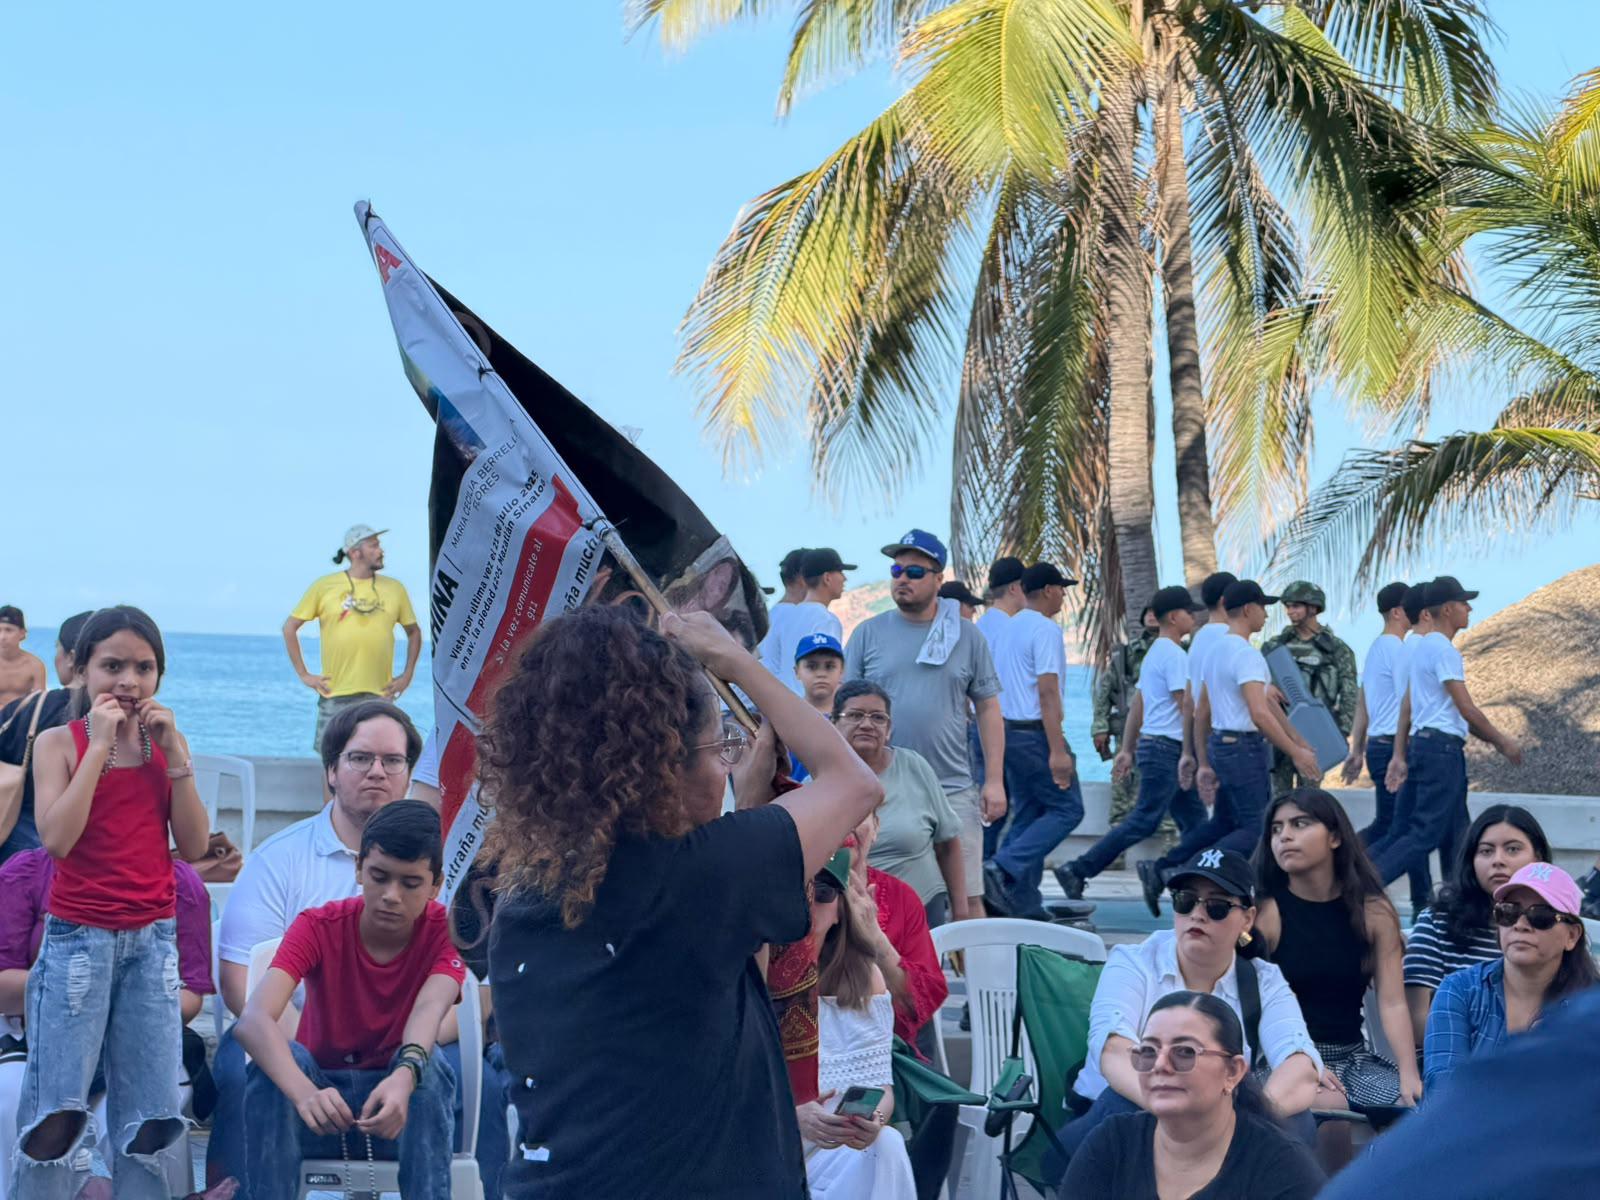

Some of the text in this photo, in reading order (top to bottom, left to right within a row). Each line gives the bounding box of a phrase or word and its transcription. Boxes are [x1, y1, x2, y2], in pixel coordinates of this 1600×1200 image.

[520, 470, 539, 497] 2025
[496, 498, 519, 525] julio
[451, 516, 469, 548] MARIA
[495, 523, 502, 537] de
[489, 548, 497, 561] el
[483, 562, 494, 580] vez
[500, 639, 511, 652] la
[506, 616, 520, 638] vez
[534, 538, 543, 553] al
[527, 601, 538, 621] 911
[460, 656, 470, 671] en
[471, 628, 481, 640] la
[477, 589, 496, 629] piedad
[463, 615, 474, 635] por
[450, 635, 466, 659] Vista
[446, 832, 475, 890] extraña
[1197, 849, 1225, 869] NY
